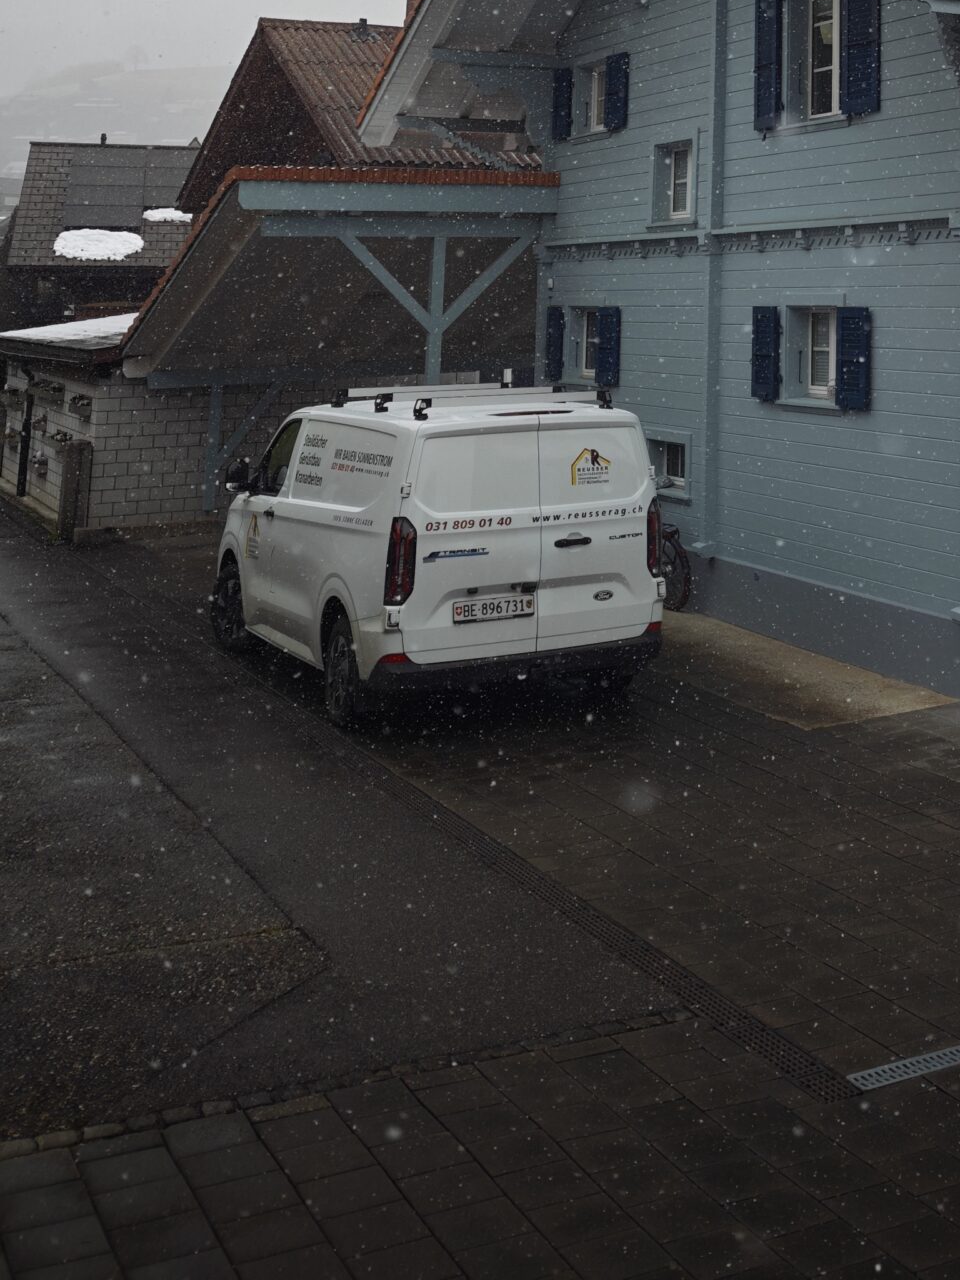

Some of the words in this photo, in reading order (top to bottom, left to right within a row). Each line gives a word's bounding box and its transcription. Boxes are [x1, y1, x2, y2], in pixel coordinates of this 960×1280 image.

[303, 434, 328, 448] Steildächer
[299, 452, 321, 467] Gerüstbau
[334, 448, 342, 460] WIR
[342, 450, 357, 462] BAUEN
[357, 451, 393, 467] SONNENSTROM
[295, 470, 323, 487] Kranarbeiten
[532, 504, 643, 523] www.reusserag.ch
[425, 521, 448, 532] 031
[452, 520, 475, 530] 809
[478, 518, 493, 528] 01
[496, 516, 512, 526] 40
[608, 532, 643, 540] CUSTOM
[442, 547, 487, 555] TRANSIT
